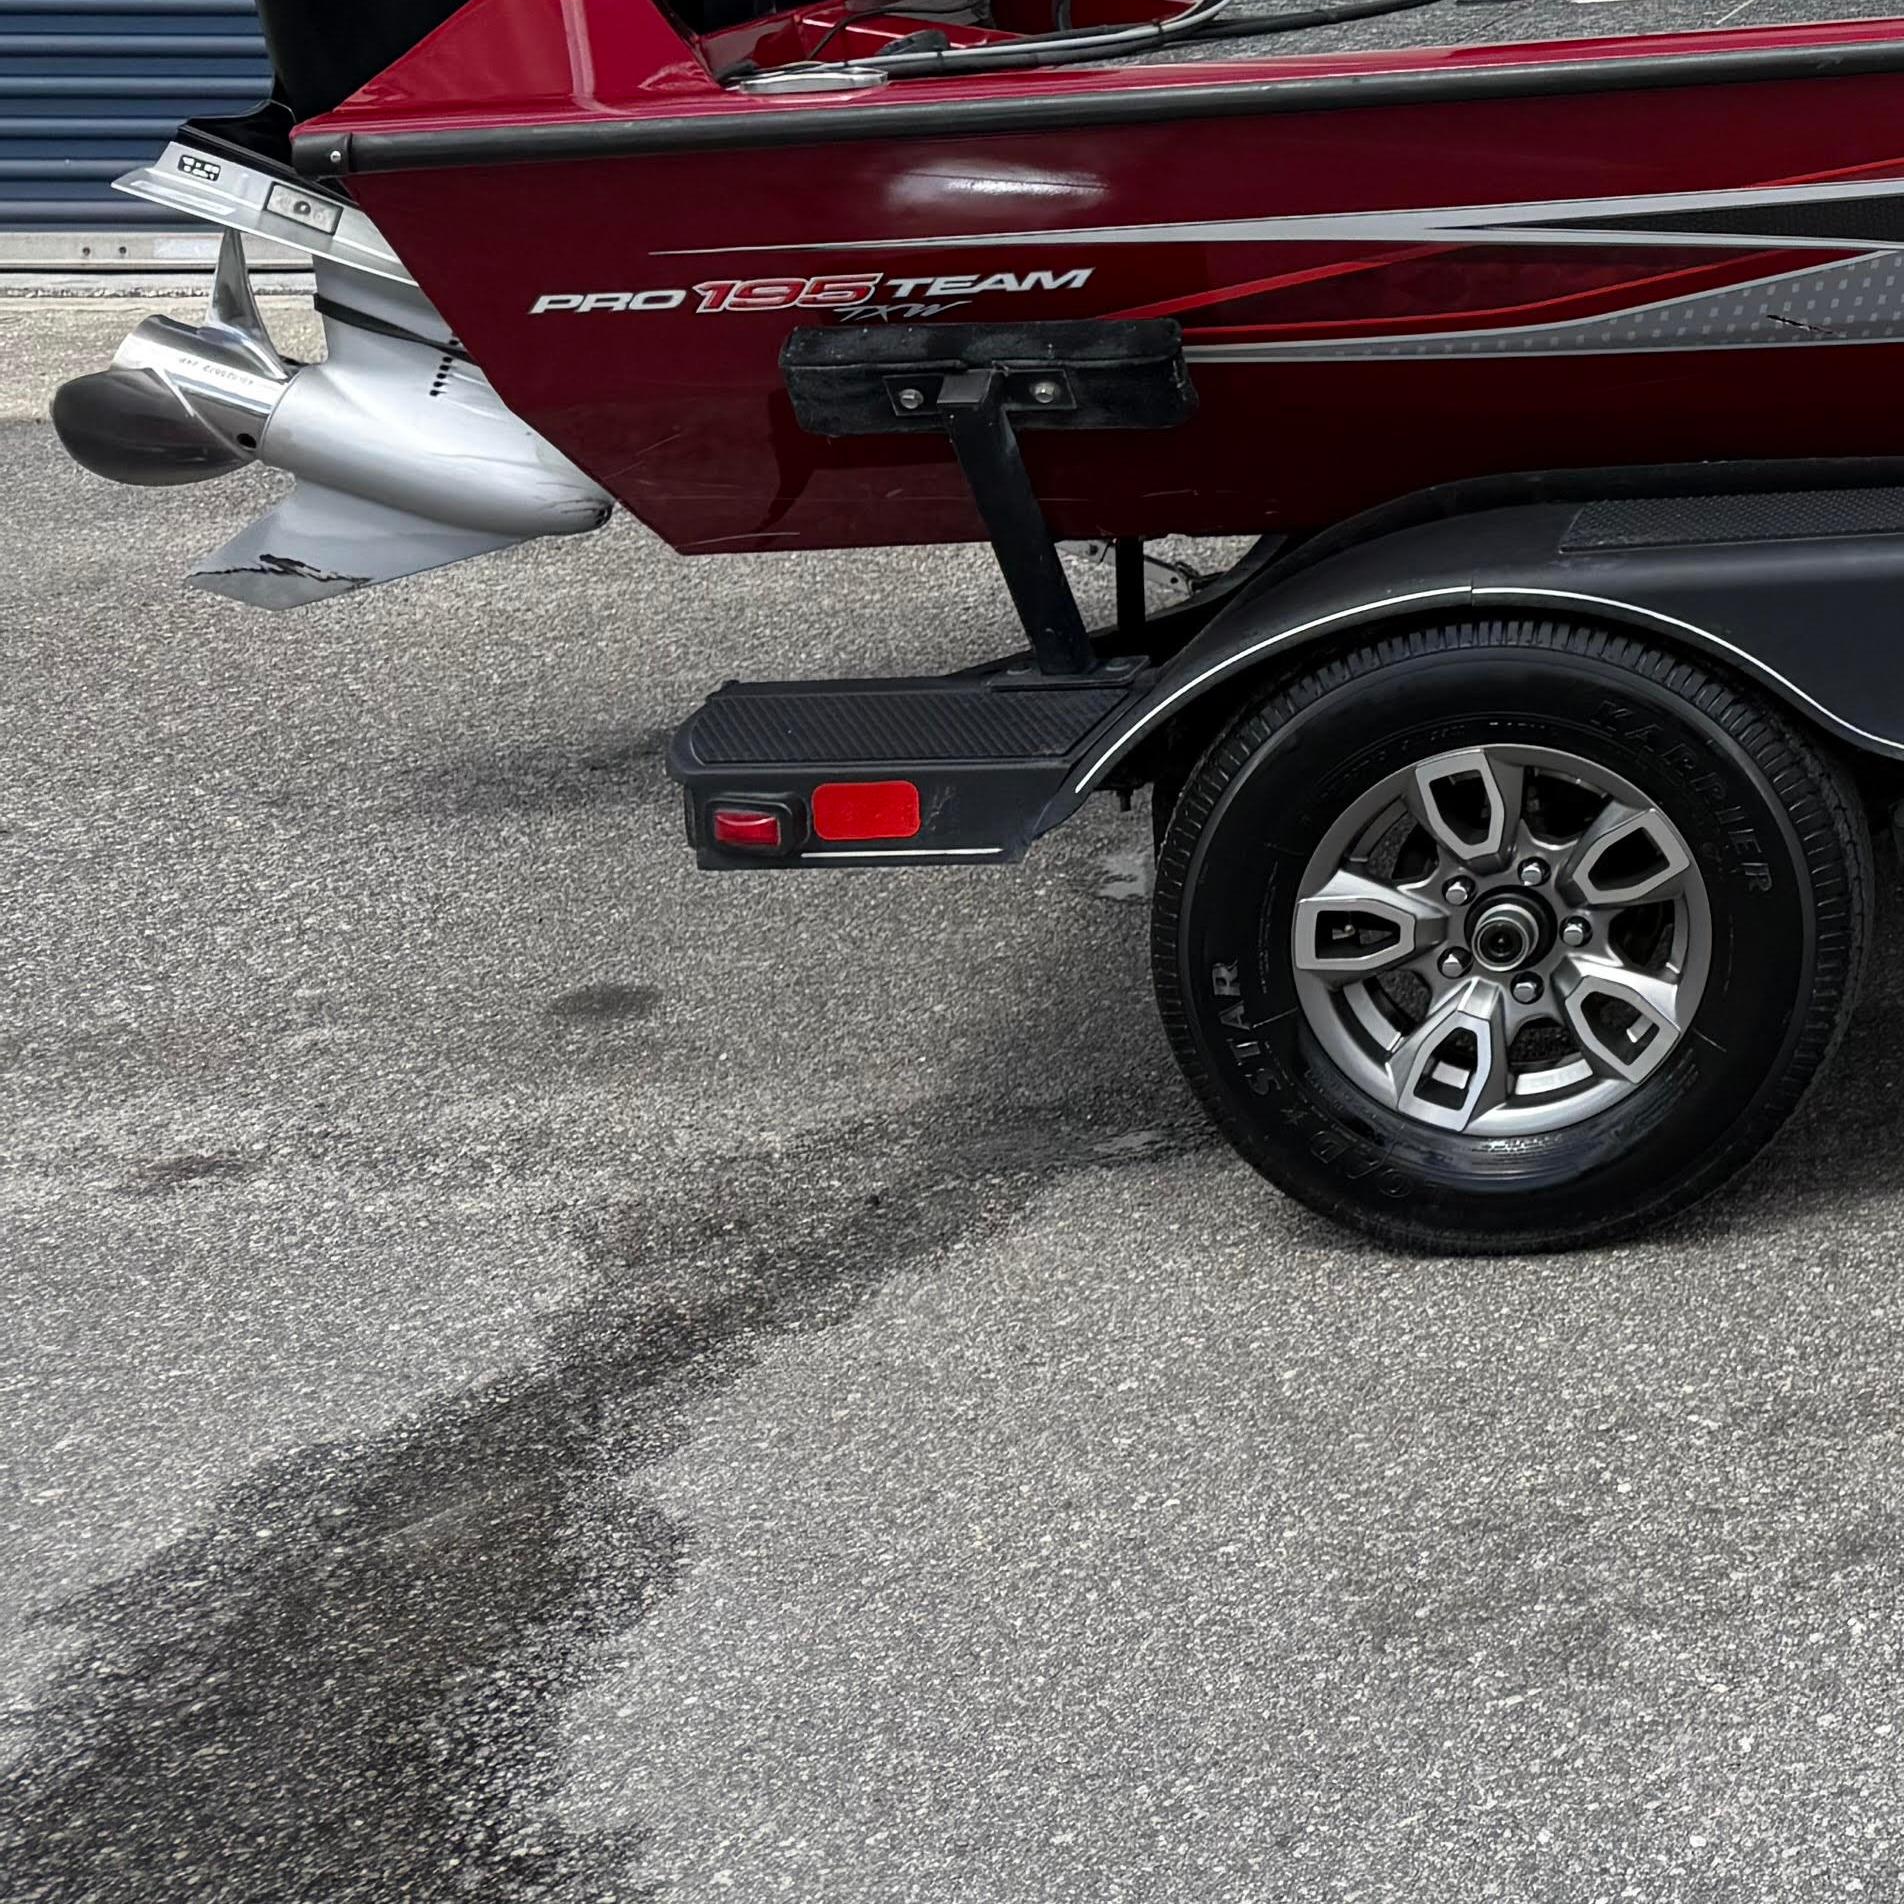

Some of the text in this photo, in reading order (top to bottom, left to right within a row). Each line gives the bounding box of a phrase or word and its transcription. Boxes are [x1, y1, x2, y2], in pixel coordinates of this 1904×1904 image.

[529, 267, 1095, 315] PRO 195 TEAM
[832, 300, 973, 323] TXW
